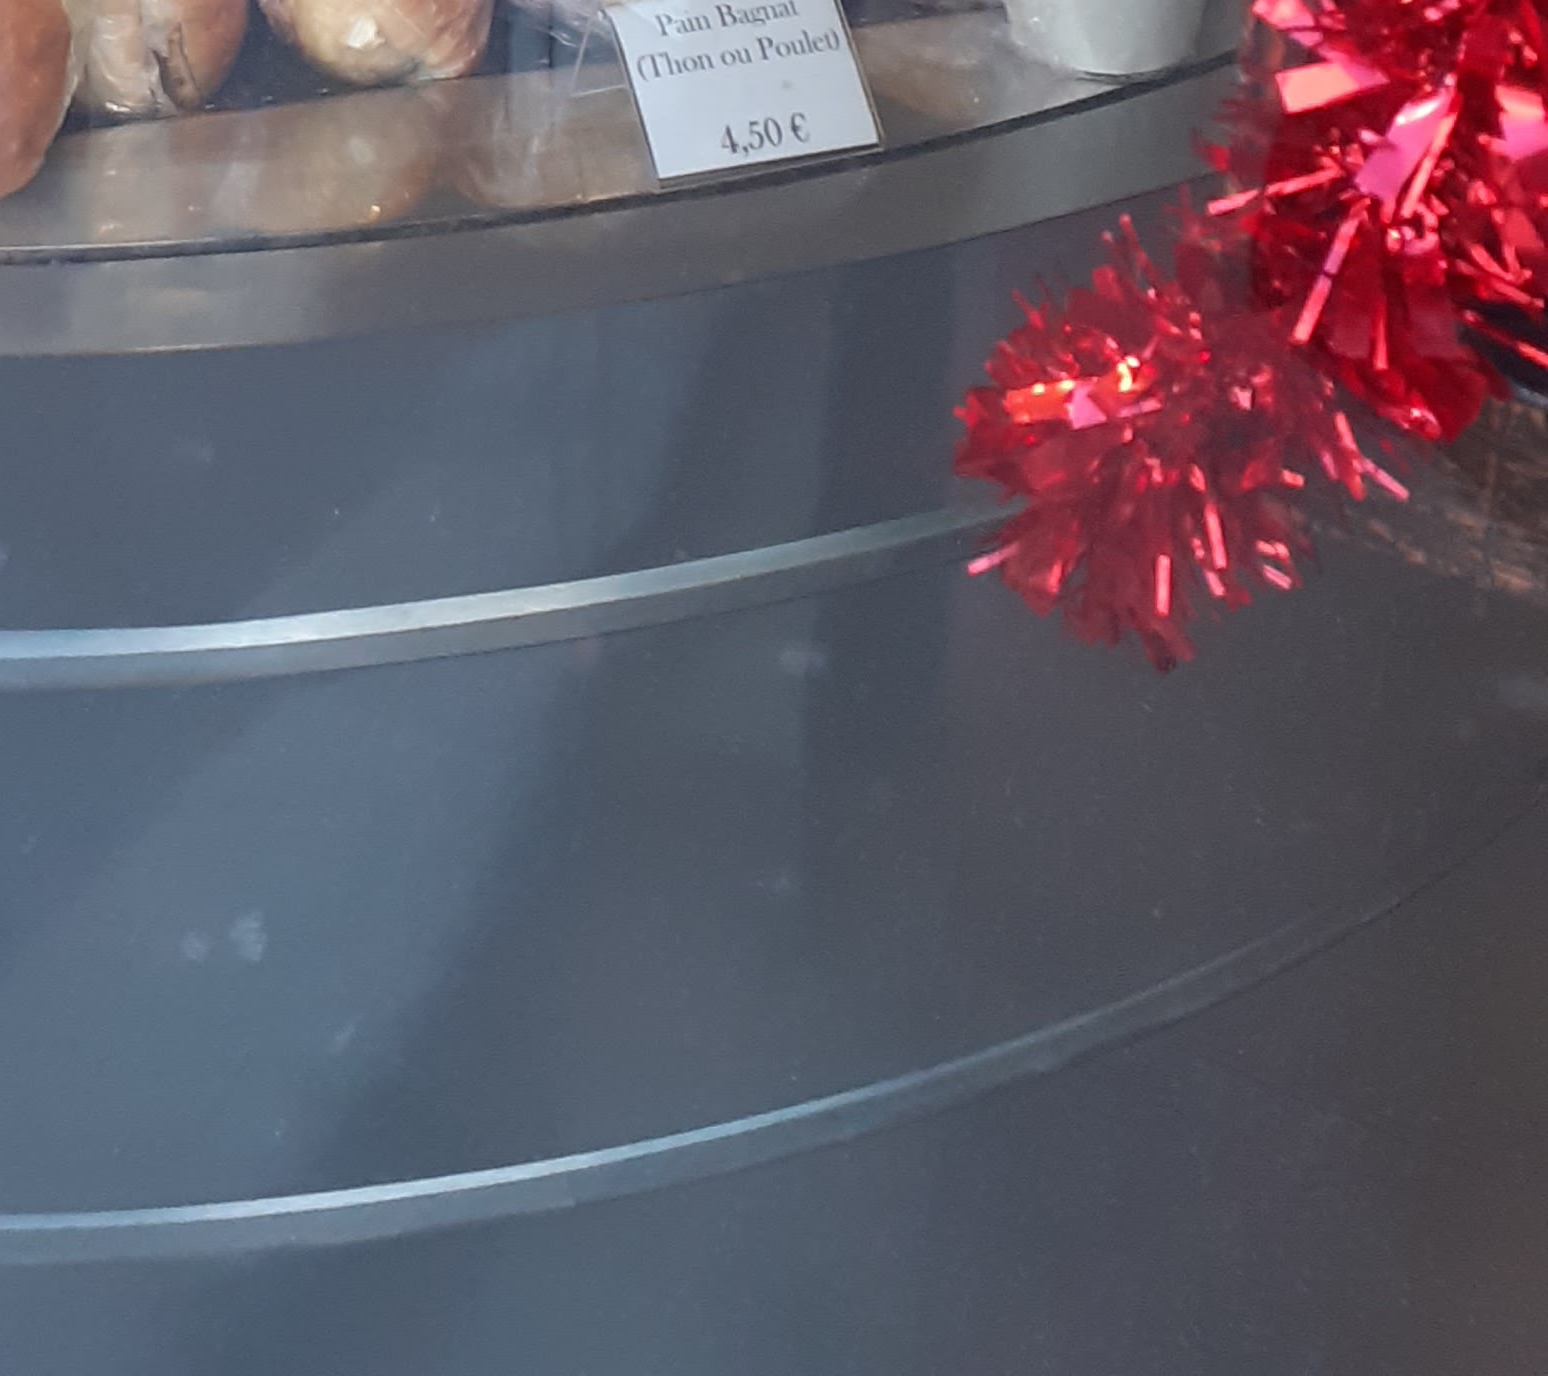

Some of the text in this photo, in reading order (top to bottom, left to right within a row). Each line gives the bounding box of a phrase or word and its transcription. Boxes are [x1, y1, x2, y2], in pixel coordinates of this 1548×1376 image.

[655, 9, 712, 37] Pain
[637, 28, 841, 83] (Thon ou Poulet)
[720, 112, 811, 158] 4,50 €
